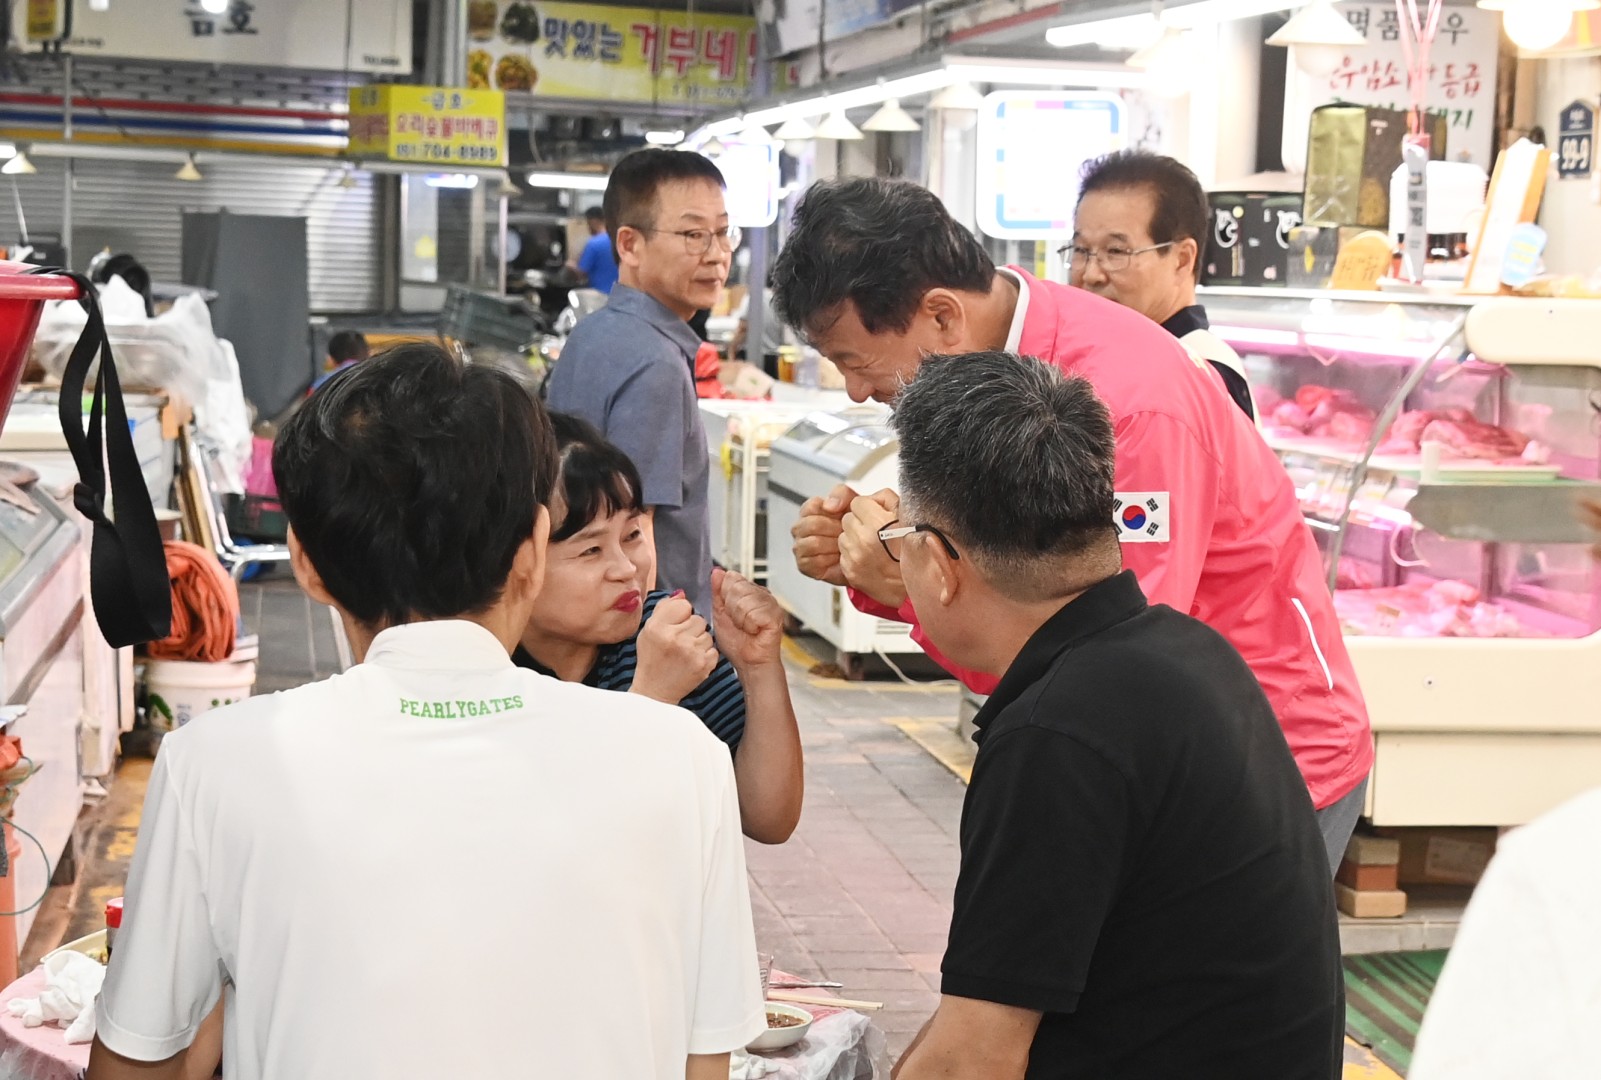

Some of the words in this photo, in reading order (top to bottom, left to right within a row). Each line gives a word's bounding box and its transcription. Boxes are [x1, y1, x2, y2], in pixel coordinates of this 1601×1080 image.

[543, 16, 624, 63] 맛있는
[1346, 8, 1469, 45] 명품우
[1330, 56, 1401, 91] 우암소
[399, 694, 524, 719] PEARLYGATES
